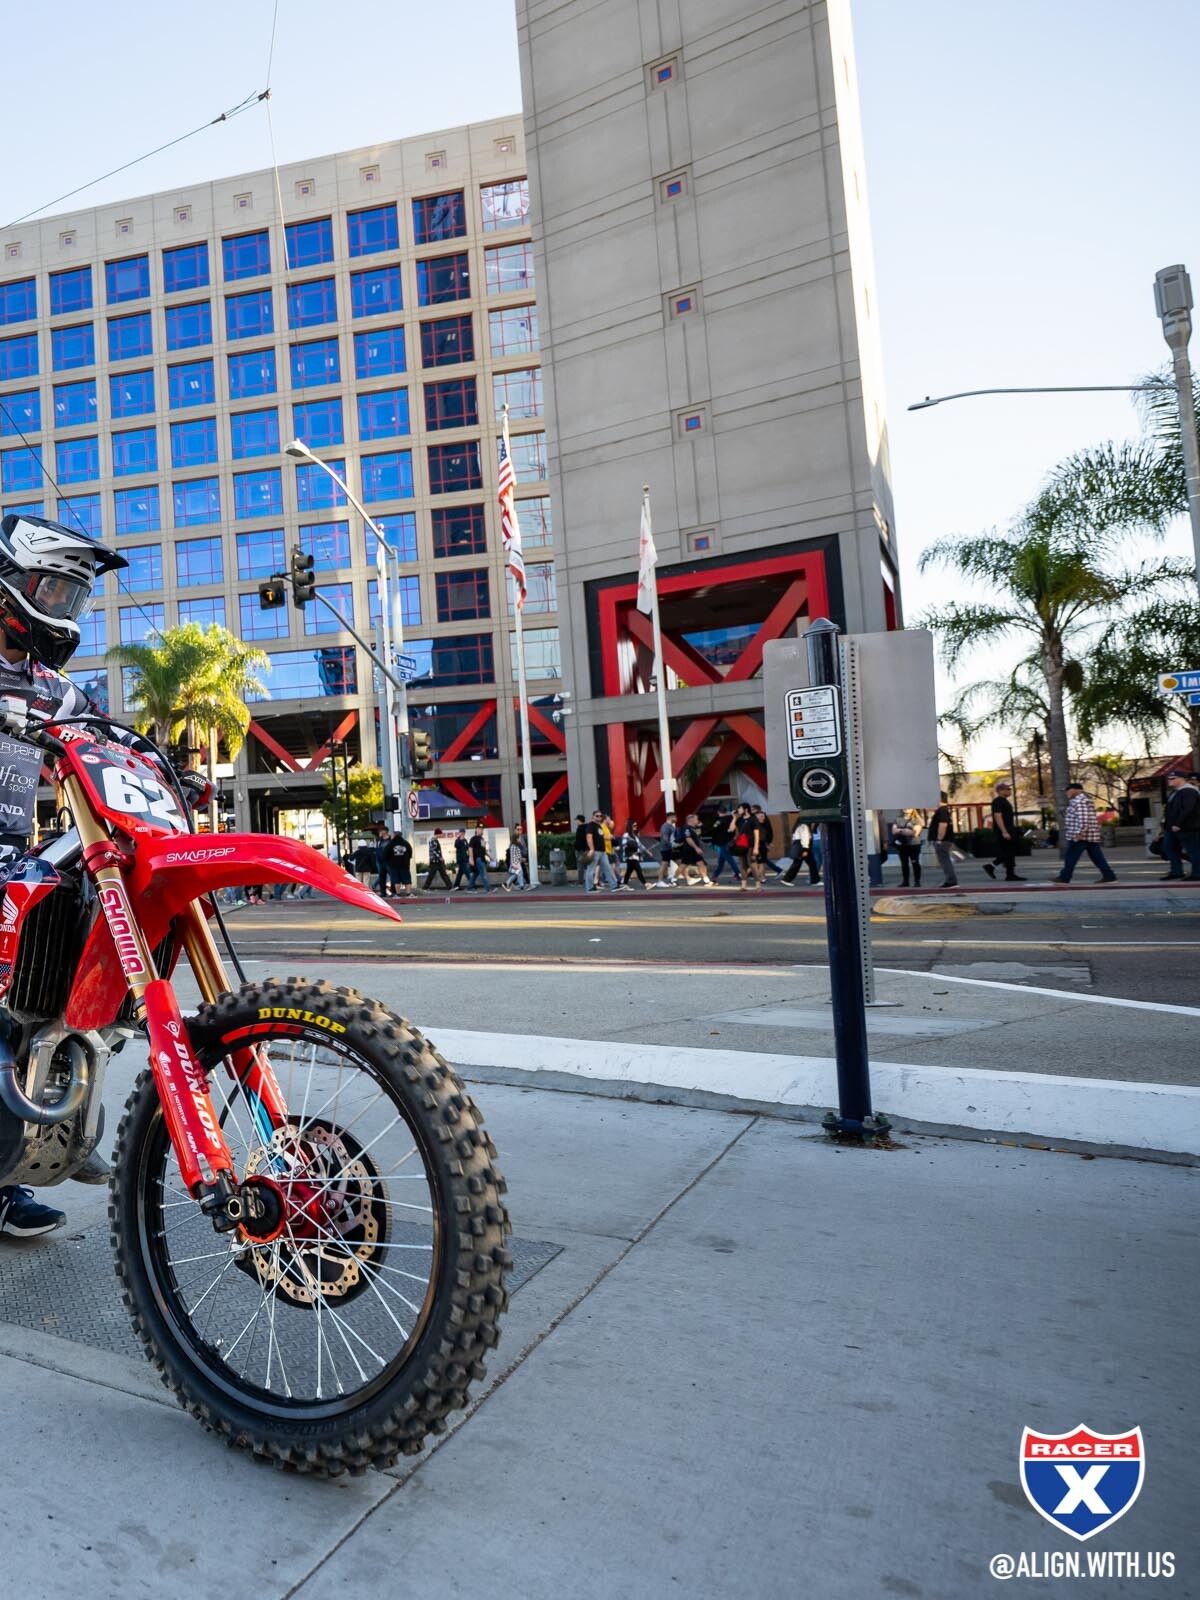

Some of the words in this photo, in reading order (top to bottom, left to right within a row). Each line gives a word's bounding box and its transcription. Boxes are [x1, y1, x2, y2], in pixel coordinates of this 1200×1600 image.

[8, 782, 28, 794] spas
[102, 766, 190, 834] 62
[445, 809, 461, 817] ATM
[97, 887, 146, 978] SHOWA
[257, 1007, 347, 1034] DUNLOP
[173, 1040, 222, 1150] DUNLOP
